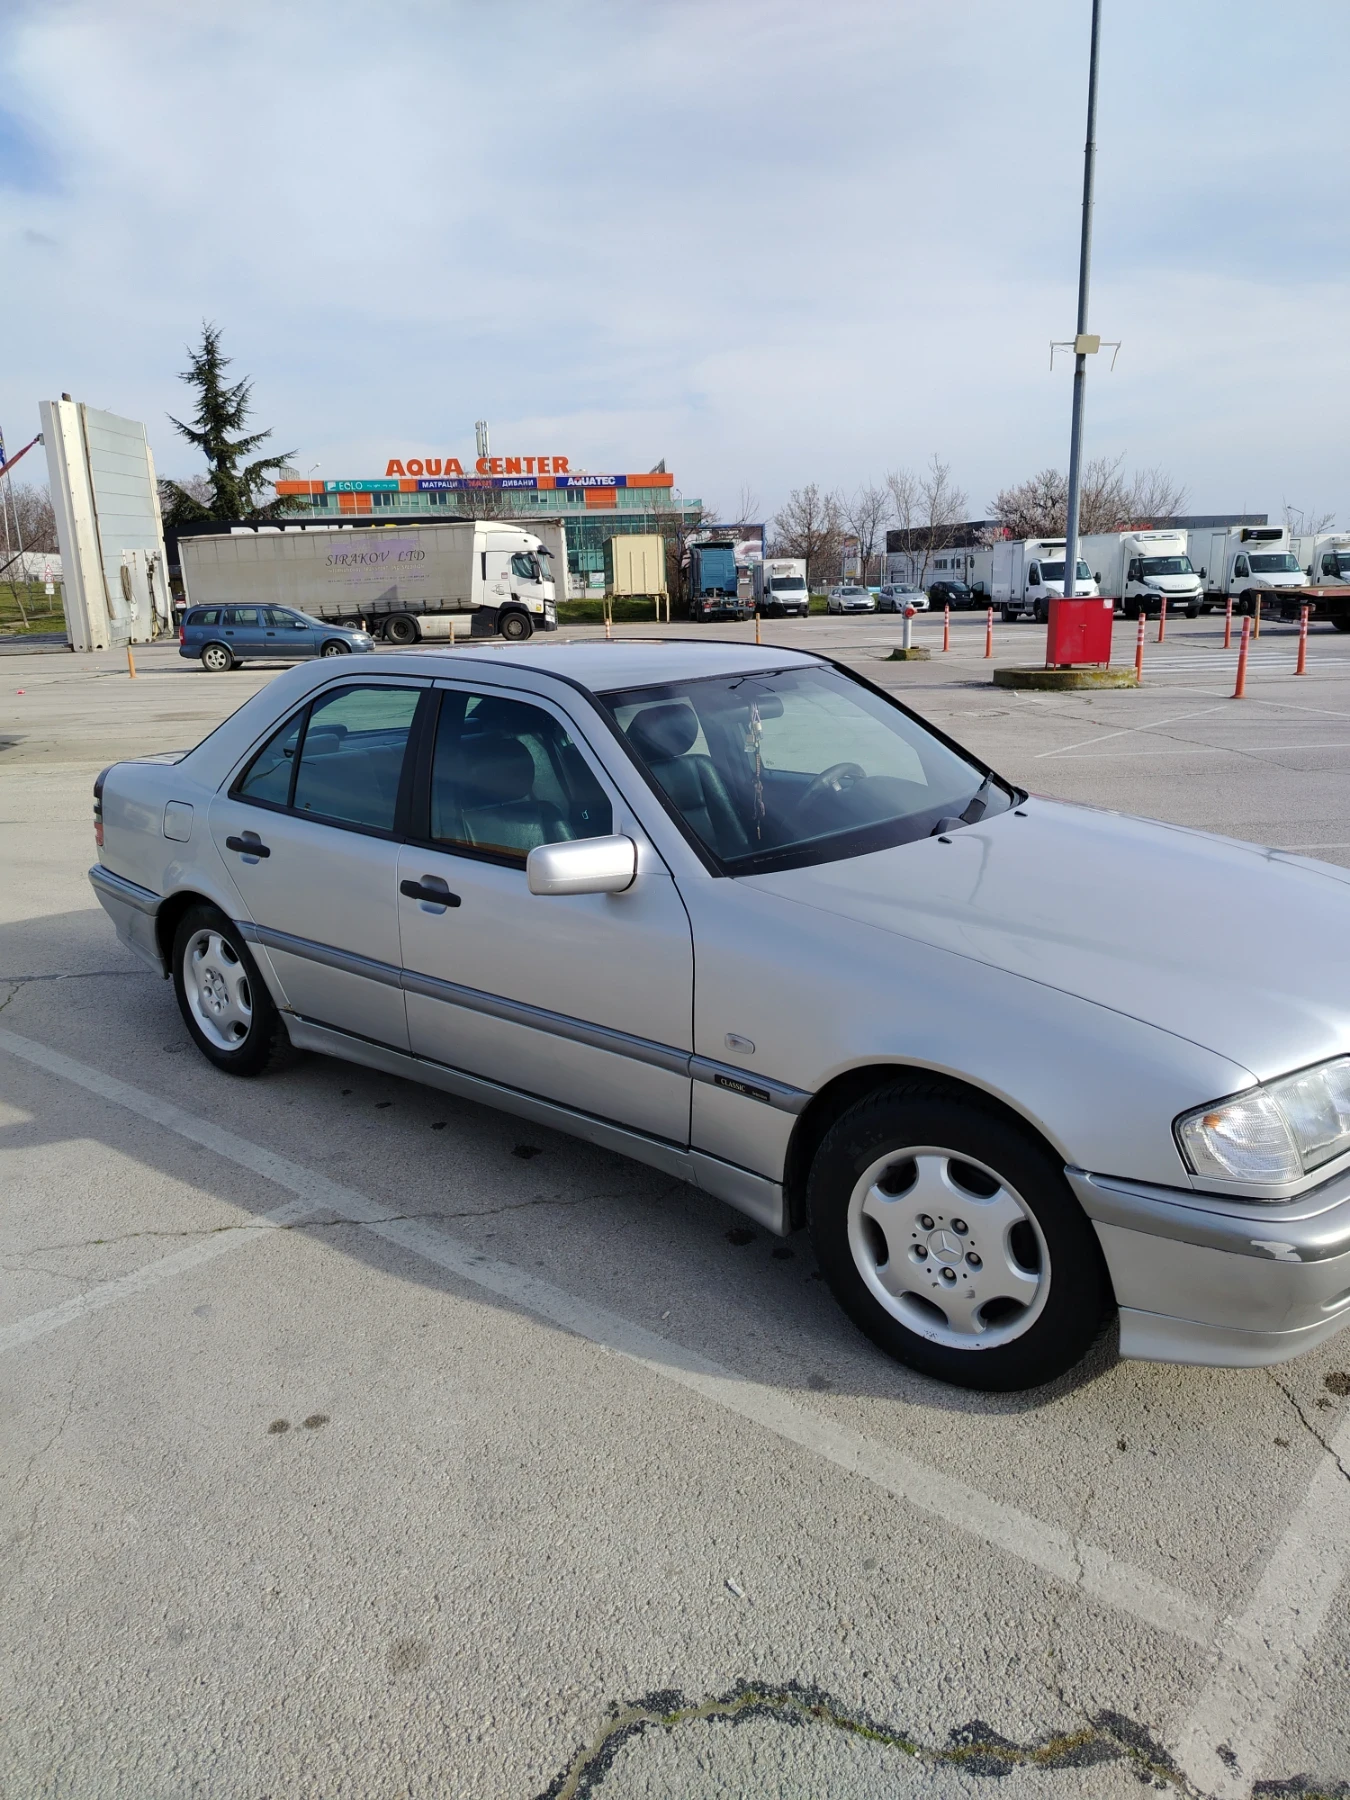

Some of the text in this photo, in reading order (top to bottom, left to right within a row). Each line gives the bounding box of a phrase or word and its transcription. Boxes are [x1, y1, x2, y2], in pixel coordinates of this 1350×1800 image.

[385, 456, 570, 477] AQUA CENTER
[422, 481, 458, 489] МАТРАЦИ
[502, 479, 534, 487] ДИВАНИ
[567, 477, 616, 486] AQUATEC
[325, 550, 425, 566] SIRAKOV LTD
[720, 1078, 746, 1092] CLASSIC
